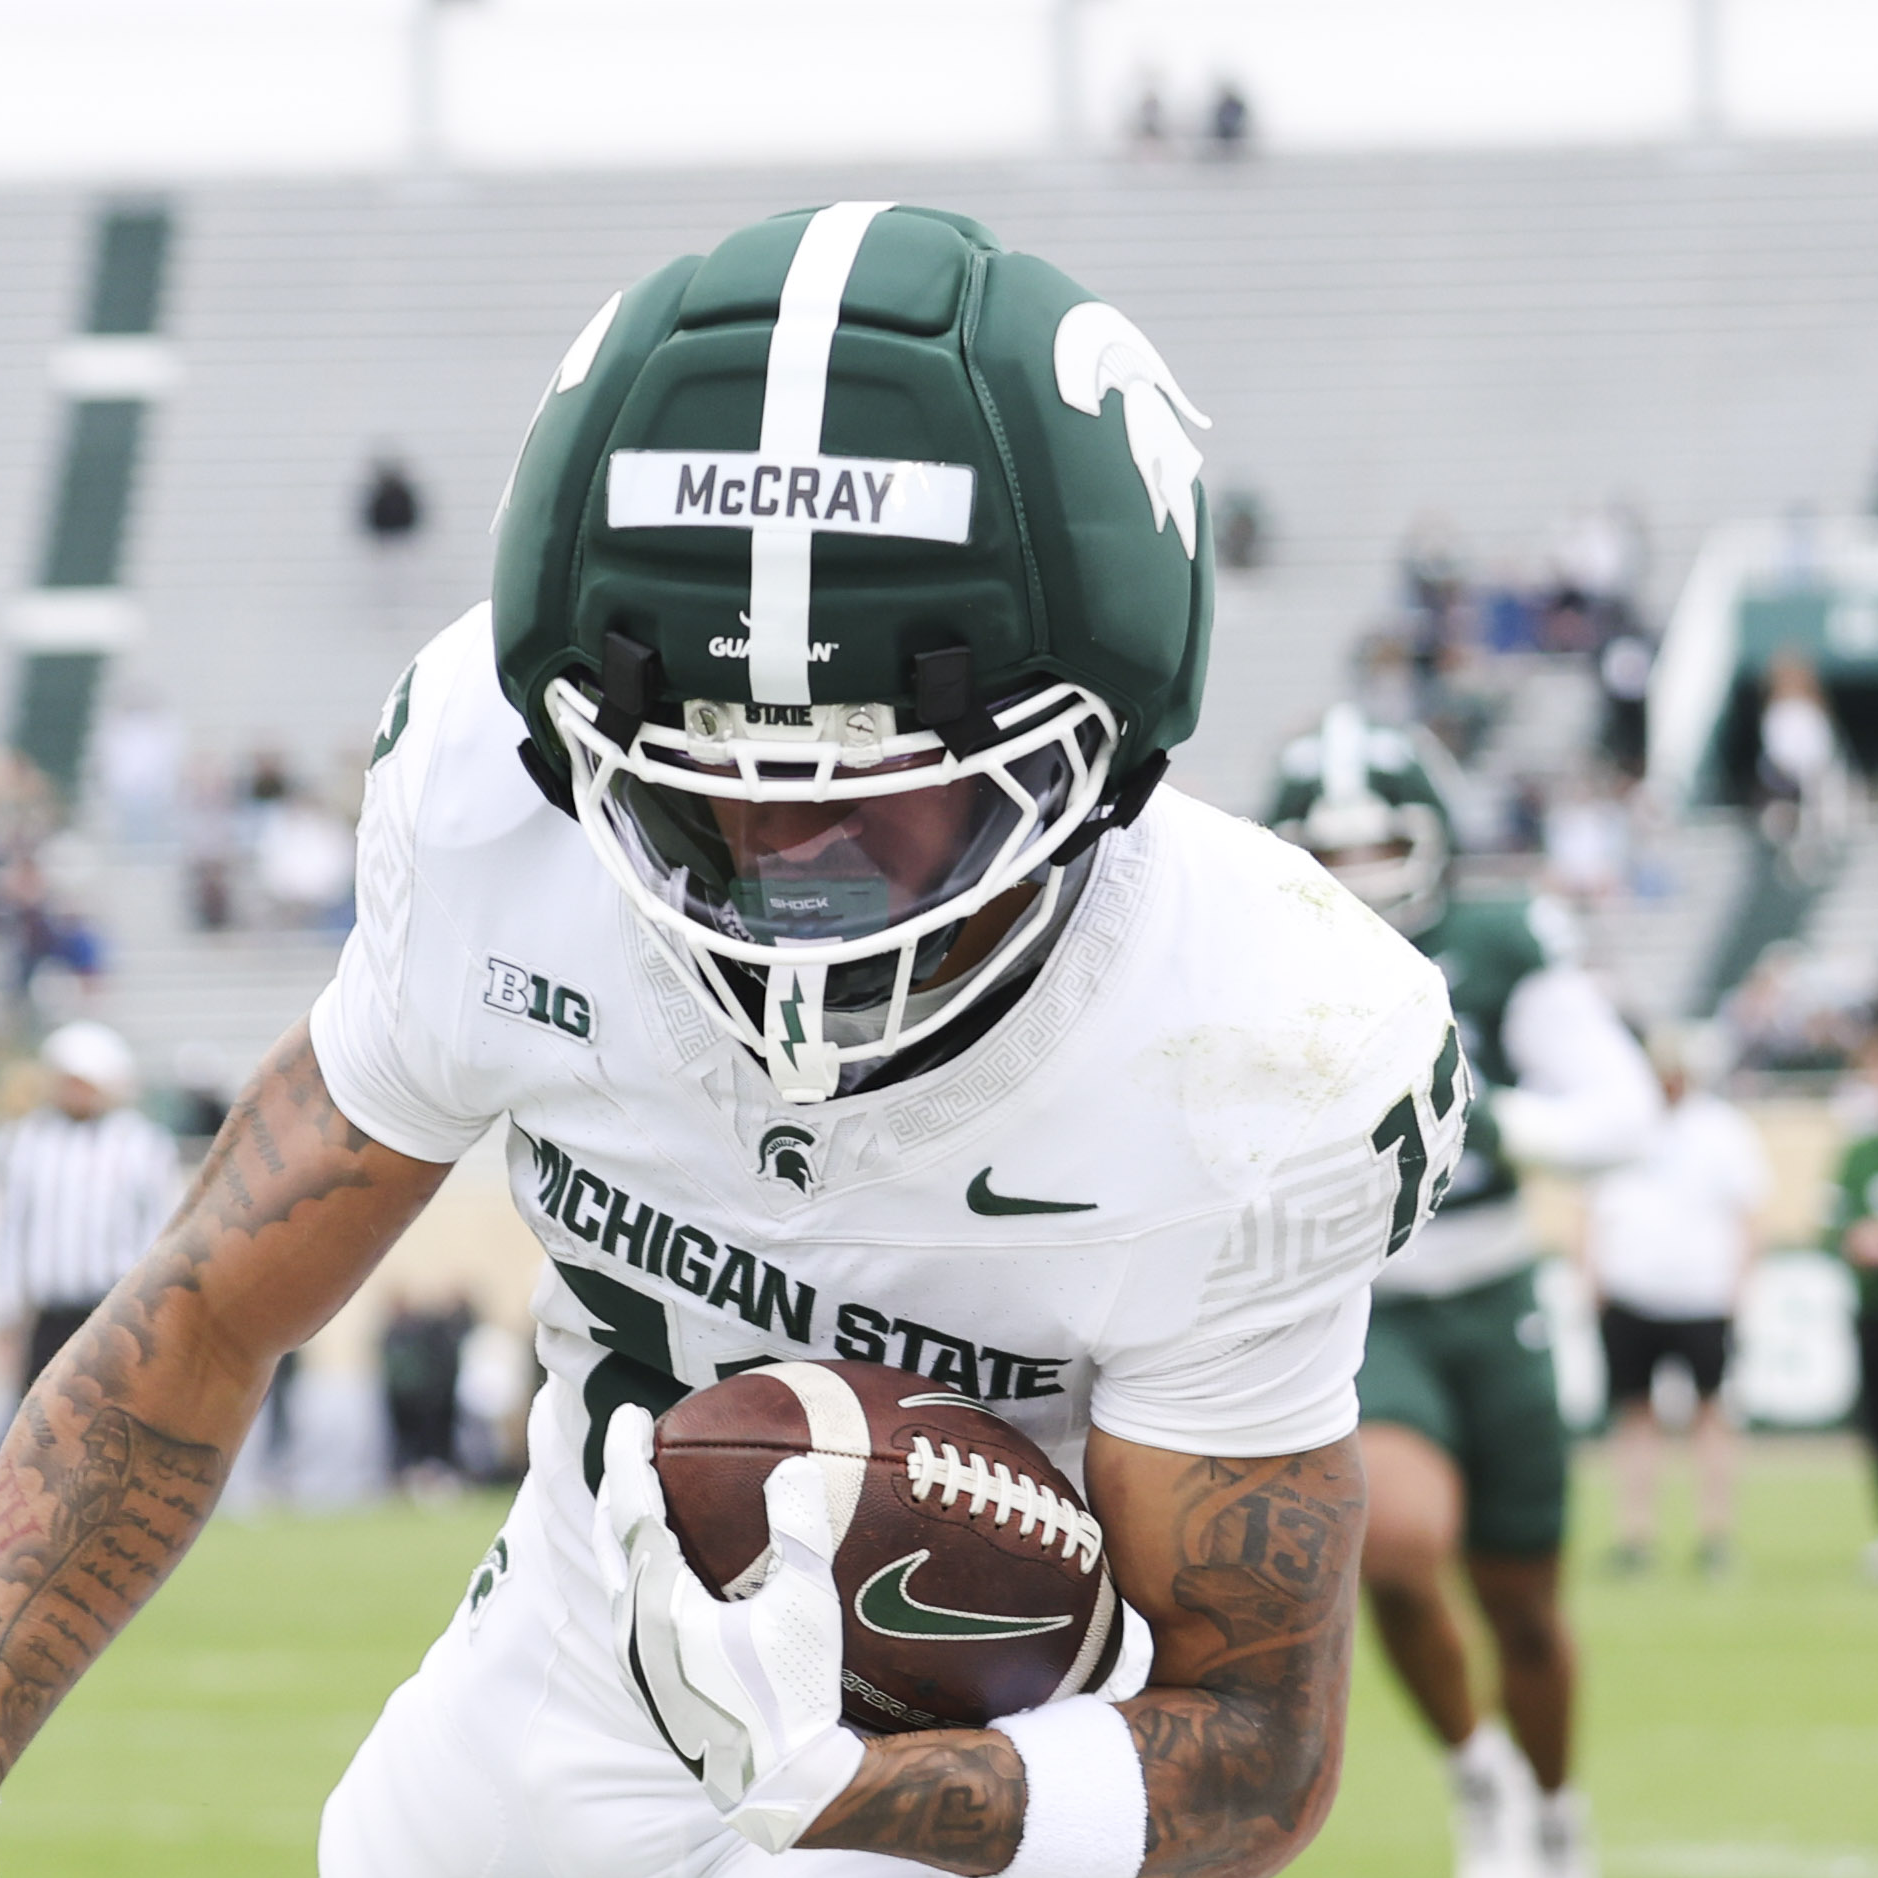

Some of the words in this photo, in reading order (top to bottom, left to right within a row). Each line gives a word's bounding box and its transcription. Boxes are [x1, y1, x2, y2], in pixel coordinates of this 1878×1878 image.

[674, 464, 895, 524] McCRAY
[769, 897, 830, 911] SHOCK
[528, 1136, 817, 1345] MICHIGAN
[833, 1302, 1073, 1400] STATE
[1237, 1493, 1327, 1584] 13
